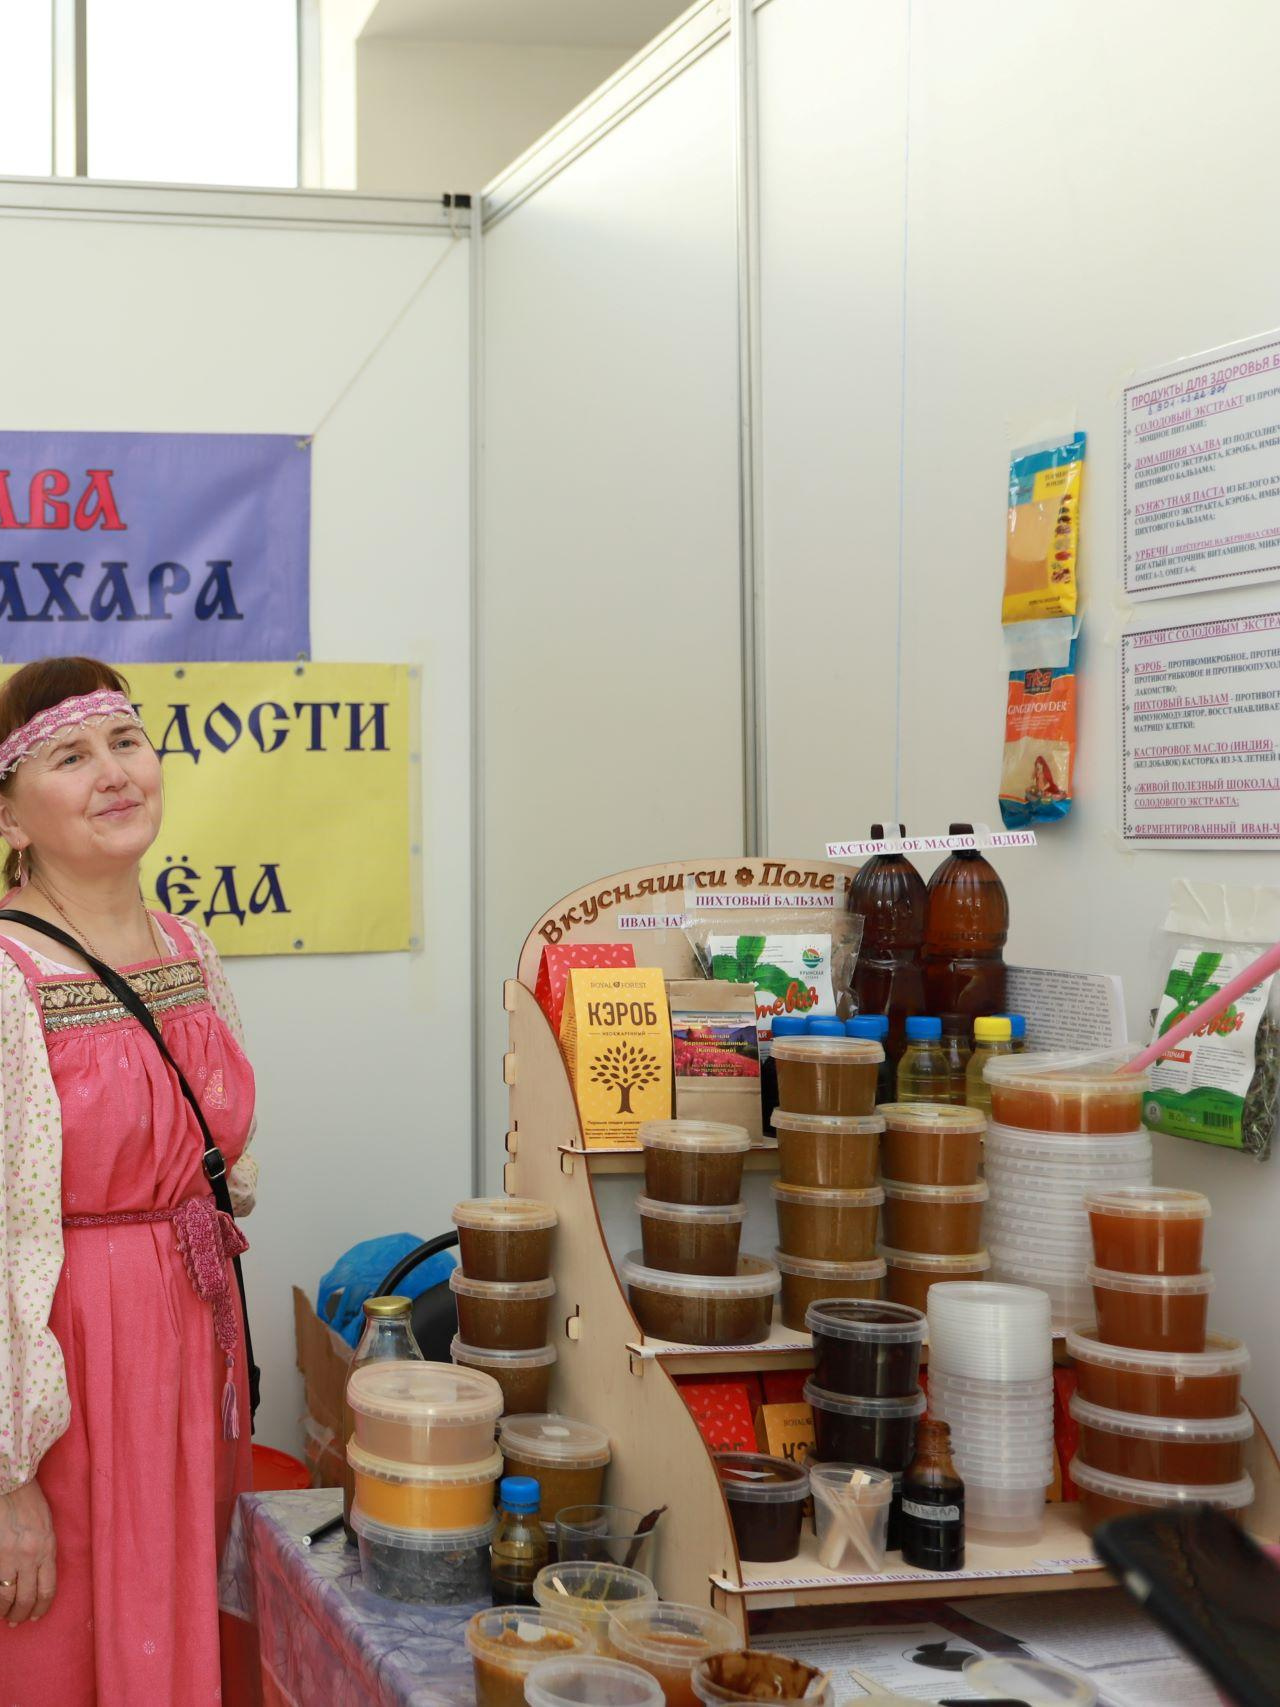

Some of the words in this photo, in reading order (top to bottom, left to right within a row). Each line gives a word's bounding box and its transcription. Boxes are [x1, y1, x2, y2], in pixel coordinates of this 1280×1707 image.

[1132, 383, 1183, 408] ПРОДУКТЫ
[1186, 375, 1208, 393] ДЛЯ
[1210, 356, 1270, 384] ЗДОРОВЬЯ
[1135, 408, 1192, 433] СОЛОДОВЫЙ
[1194, 395, 1244, 417] ЭКСТРАКТ
[1135, 445, 1188, 469] ДОМАШНЯЯ
[1189, 438, 1221, 453] ХАЛВА
[1135, 491, 1191, 514] КУНЖУТНАЯ
[1193, 486, 1225, 501] ПАСТА
[1237, 477, 1269, 492] БЕЛОГО
[1135, 545, 1169, 561] УРБЕЧИ
[1135, 558, 1167, 572] БОГАТЫЙ
[1168, 552, 1206, 567] ИСТОЧНИК
[1133, 632, 1167, 647] УРБЕЧИ
[1176, 622, 1239, 640] СОЛОДОВЫМ
[1134, 660, 1162, 674] КЭРОБ
[1026, 669, 1053, 688] TRS
[1134, 695, 1182, 712] ПИХТОВЫЙ
[1185, 692, 1229, 706] БАЛЬЗАМ
[1134, 744, 1192, 758] КАСТОРОВОЕ
[1194, 741, 1229, 755] МАСЛО
[1230, 738, 1273, 752] (ИНДИЯ)
[1182, 755, 1220, 768] КАСТОРКА
[1172, 777, 1224, 791] ПОЛЕЗНЫЙ
[1134, 797, 1186, 808] СОЛОДОВОГО
[1135, 821, 1236, 834] ФЕРМЕНТИРОВАННЫЙ
[924, 836, 975, 849] МАСЛО
[538, 870, 727, 944] Вкусняшки
[695, 891, 770, 908] ПИХТОВЫЙ
[774, 895, 835, 907] БАЛЬЗАМ
[756, 981, 819, 1019] тевия
[587, 1001, 657, 1026] КЭРОБ
